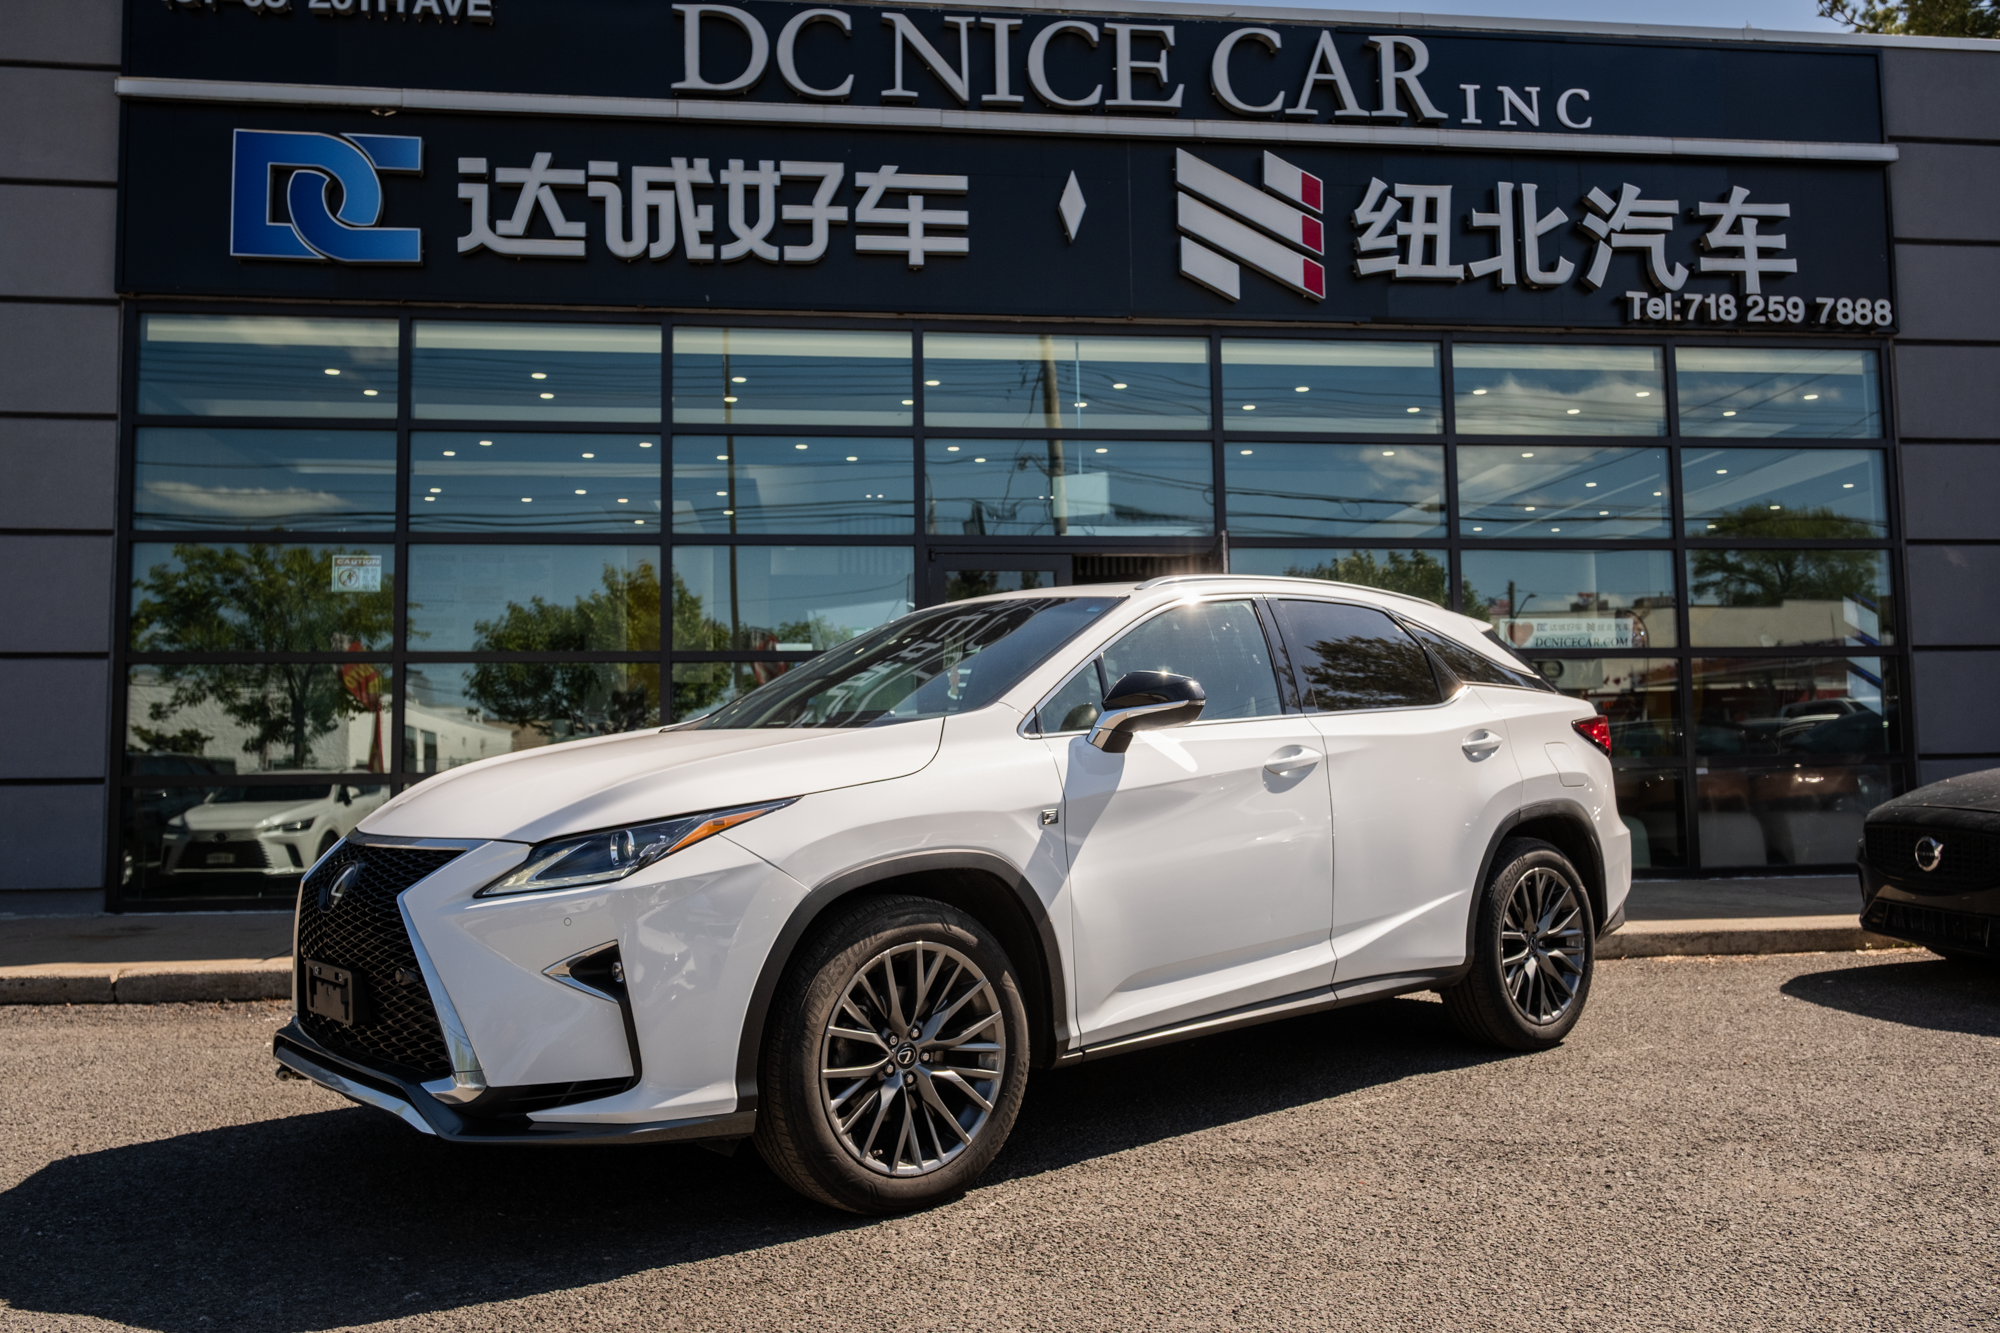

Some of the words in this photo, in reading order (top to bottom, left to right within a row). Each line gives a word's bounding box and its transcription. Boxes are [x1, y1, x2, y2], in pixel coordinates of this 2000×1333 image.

[671, 3, 854, 98] DC
[881, 12, 1185, 109] NICE
[1211, 27, 1449, 119] CAR
[1459, 83, 1593, 129] INC
[230, 128, 422, 263] DC
[457, 152, 969, 268] 达诚好车
[1353, 176, 1798, 294] 纽北汽车
[1746, 294, 1806, 324] 259
[1815, 297, 1893, 327] 7888
[1535, 637, 1629, 648] DCNICECAR.COM
